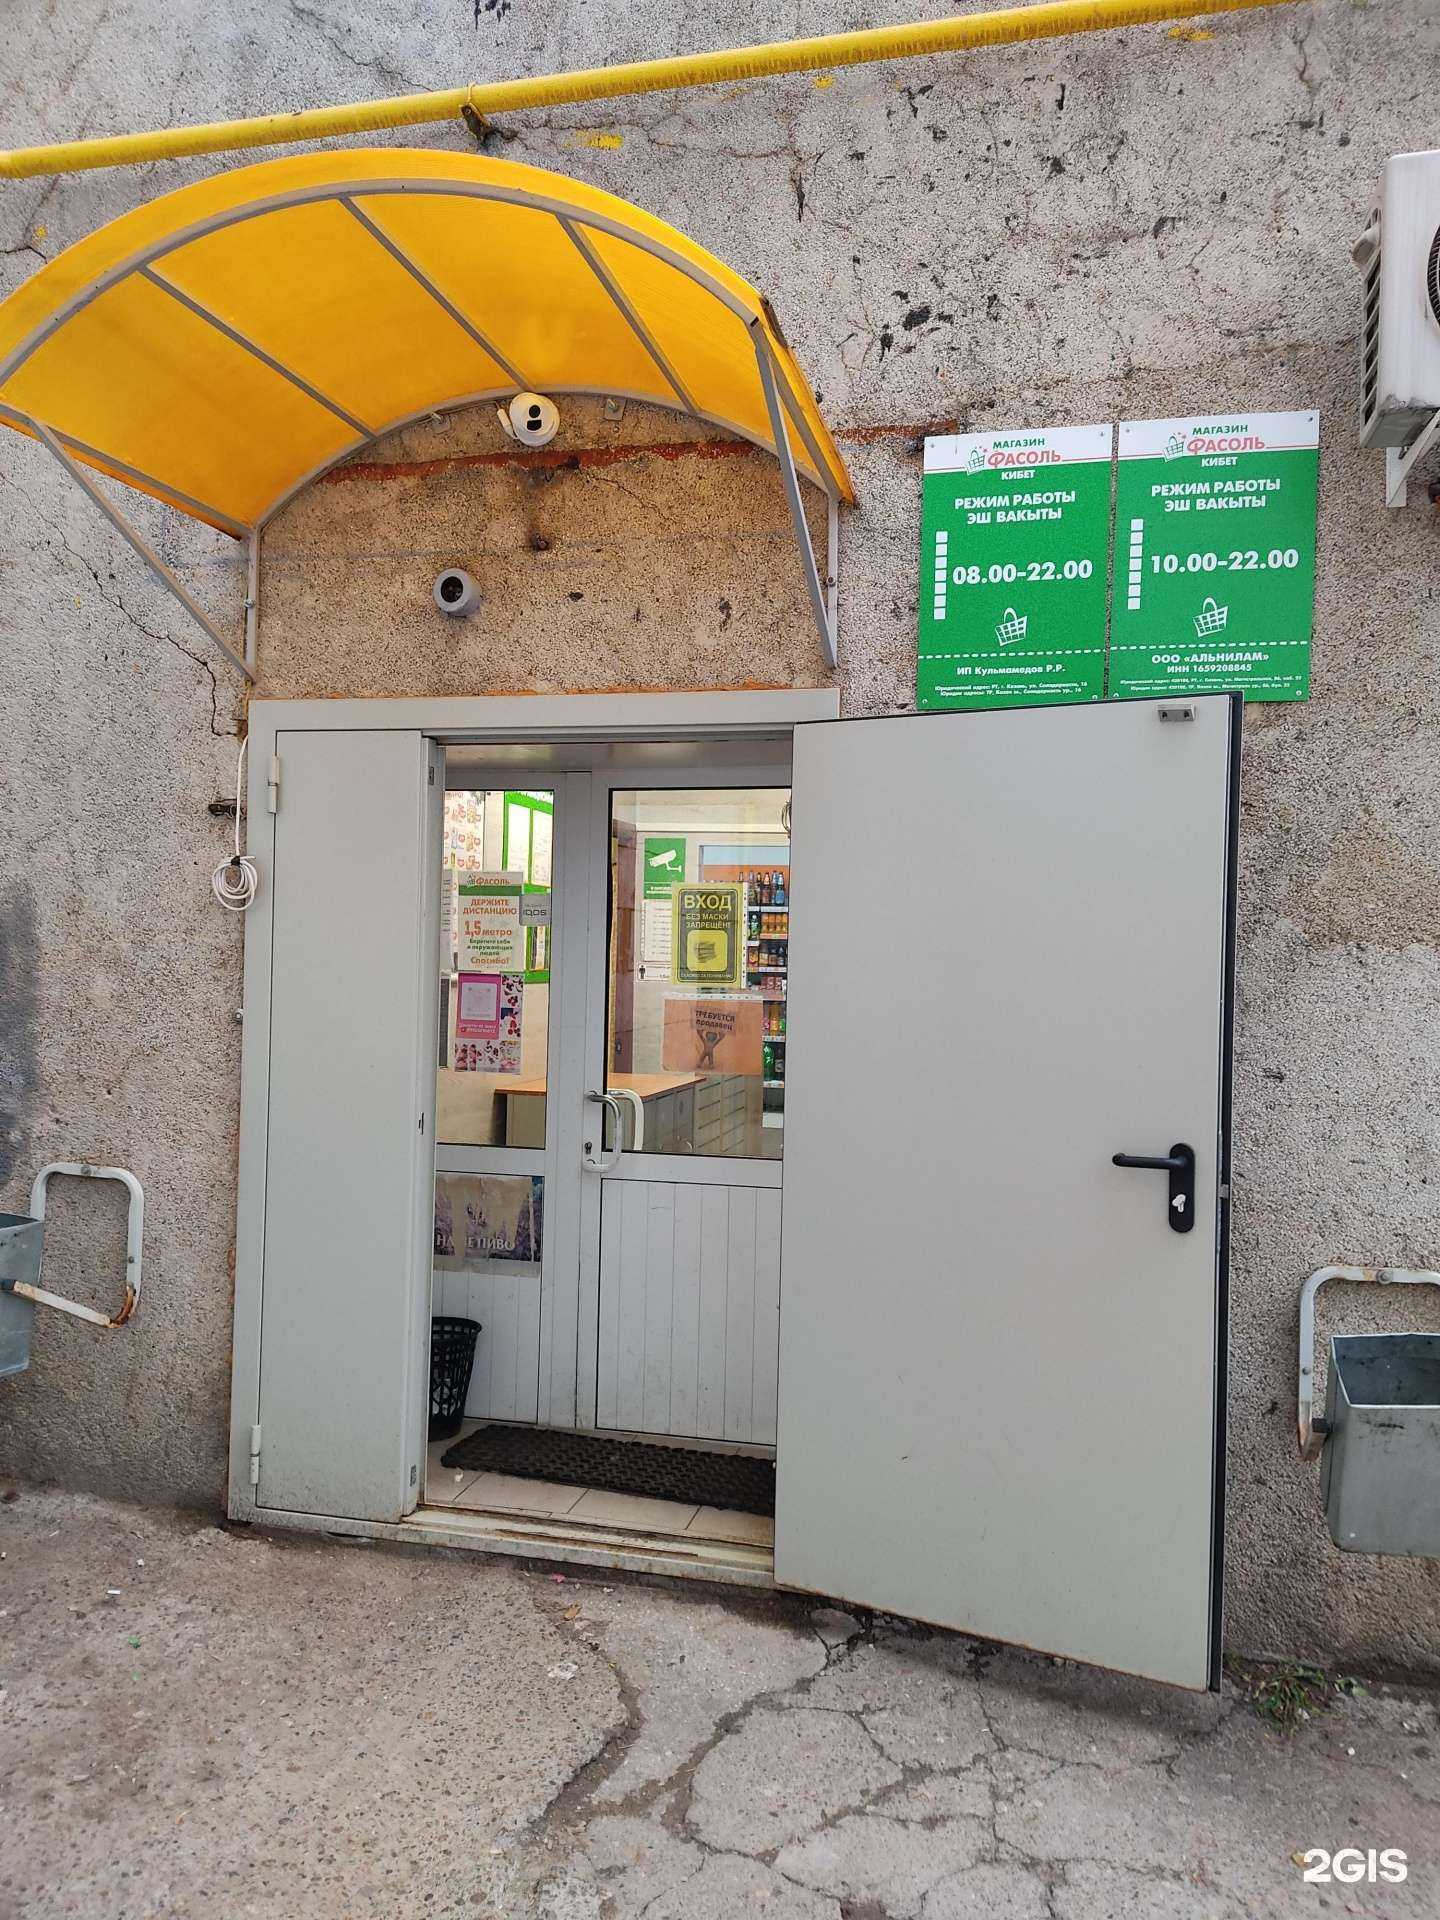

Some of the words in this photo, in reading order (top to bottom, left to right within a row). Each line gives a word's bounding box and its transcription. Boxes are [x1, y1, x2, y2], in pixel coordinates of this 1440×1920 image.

[1192, 425, 1248, 435] МАГАЗИН
[993, 438, 1045, 450] МАГАЗИН
[1187, 436, 1266, 454] ФАСОЛЬ
[988, 450, 1061, 468] ФАСОЛЬ
[1201, 456, 1238, 467] КИБЕТ
[1001, 470, 1035, 480] КИБЕТ
[1151, 482, 1210, 497] РЕЖИМ
[1213, 478, 1280, 493] РАБОТЫ
[955, 495, 1009, 509] РЕЖИМ
[1012, 491, 1076, 506] РАБОТЫ
[1164, 499, 1190, 512] ЭШ
[1196, 495, 1266, 510] ВАКЫТЫ
[967, 512, 991, 525] ЭШ
[996, 508, 1062, 523] ВАКЫТЫ
[1150, 548, 1300, 574] 10.00-22.00
[952, 559, 1093, 586] 08.00-22.00
[1152, 654, 1180, 664] ООО
[1184, 652, 1269, 662] «АЛЬНИЛАМ»
[956, 667, 972, 675] ИП
[975, 666, 1043, 676] Кульмамедов
[1046, 664, 1066, 672] Р.Р.
[1167, 665, 1190, 674] ИНН
[1193, 664, 1252, 673] 1659208845
[476, 877, 511, 886] ФАСОЛЬ
[470, 898, 510, 906] ДЕРЖИТЕ
[684, 894, 732, 911] ВХОД
[463, 907, 517, 915] ДИСТАНЦИЮ
[464, 920, 481, 937] 1,5
[696, 1010, 735, 1022] ТРЕБУЕТСЯ
[477, 1238, 515, 1250] ПИВО
